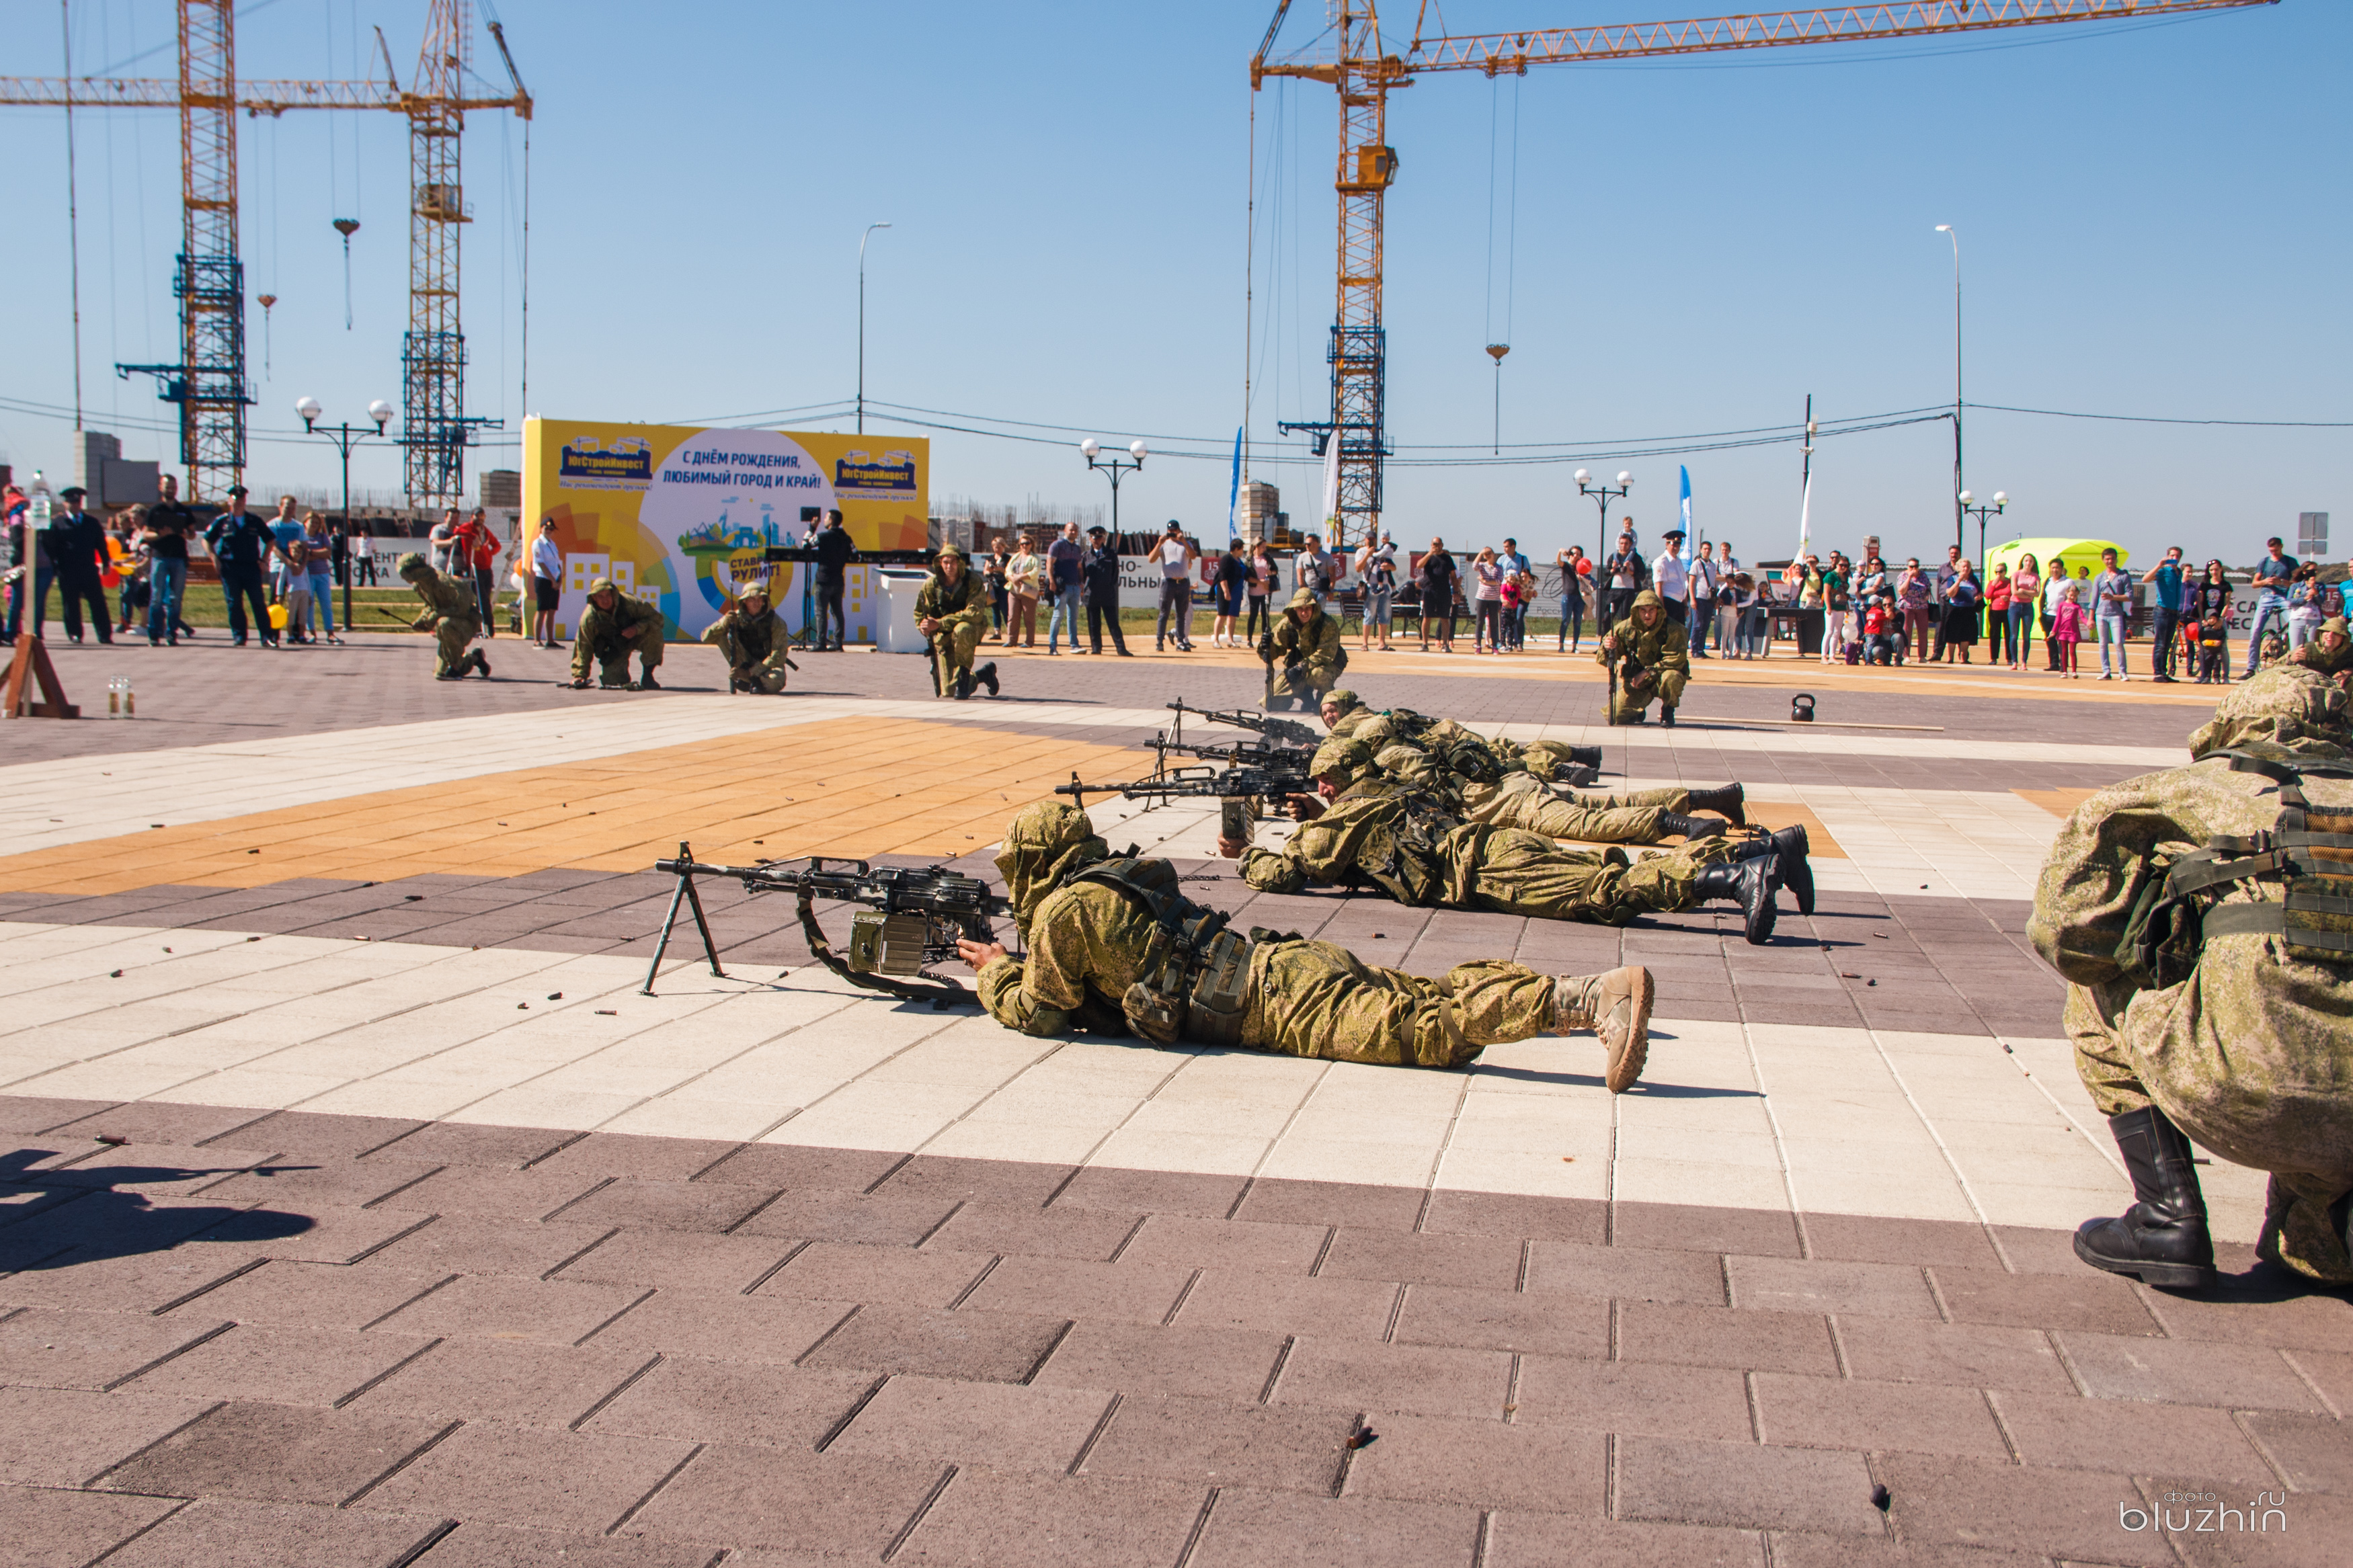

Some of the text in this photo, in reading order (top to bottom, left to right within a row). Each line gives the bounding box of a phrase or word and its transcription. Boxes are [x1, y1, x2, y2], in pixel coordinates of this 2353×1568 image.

[568, 456, 644, 469] ЮгСтройИнвест
[683, 449, 801, 469] С ДНЁМ РОЖДЕНИЯ,
[663, 470, 821, 489] ЛЮБИМЫЙ ГОРОД И КРАЙ!
[842, 468, 909, 481] ЮгСтройИнвест
[731, 556, 767, 568] СТАВР
[1208, 562, 1218, 571] 15
[731, 564, 780, 581] РУЛИТ!
[2326, 591, 2339, 602] 15
